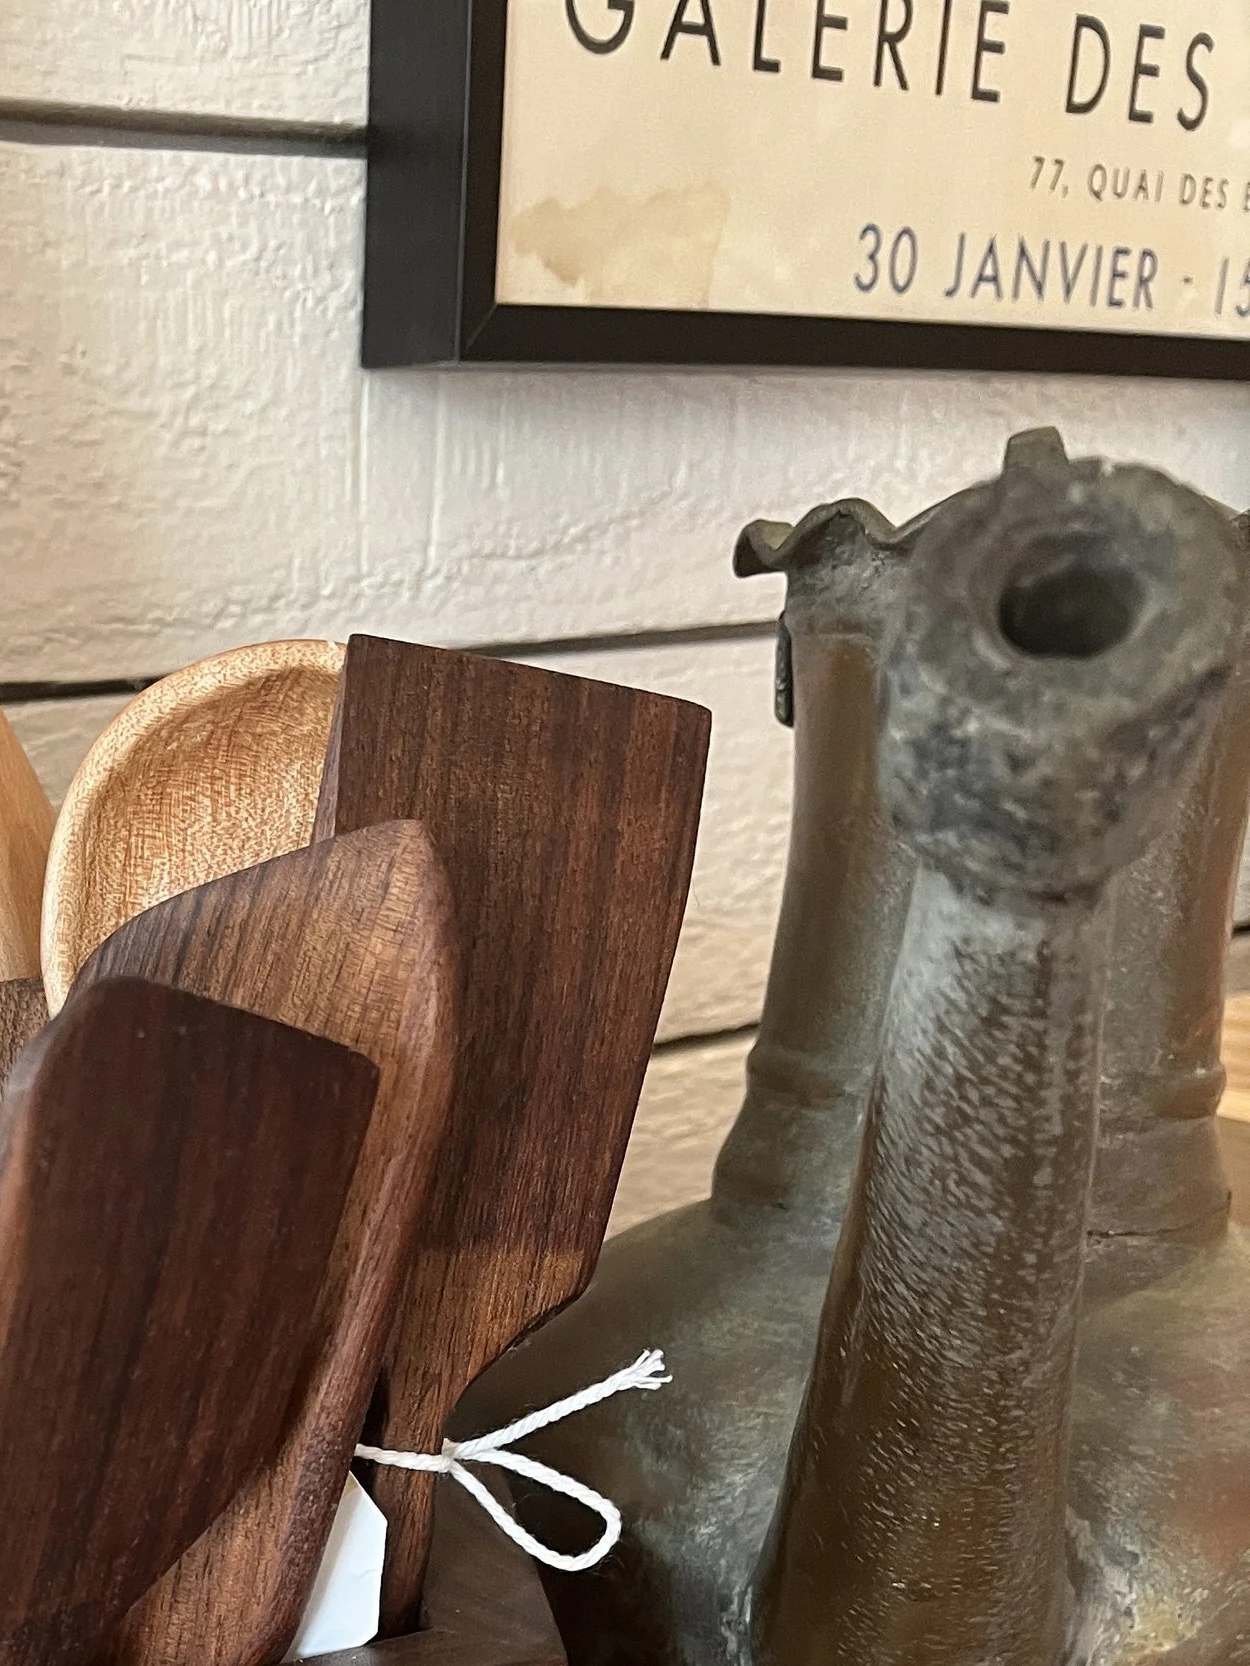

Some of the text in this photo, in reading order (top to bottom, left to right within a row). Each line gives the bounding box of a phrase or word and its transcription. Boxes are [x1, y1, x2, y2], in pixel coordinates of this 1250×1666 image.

[1065, 13, 1215, 131] DES
[1087, 163, 1165, 202] QUAI
[1179, 174, 1229, 210] DES
[853, 222, 918, 295] 30
[944, 232, 1159, 310] JANVIER
